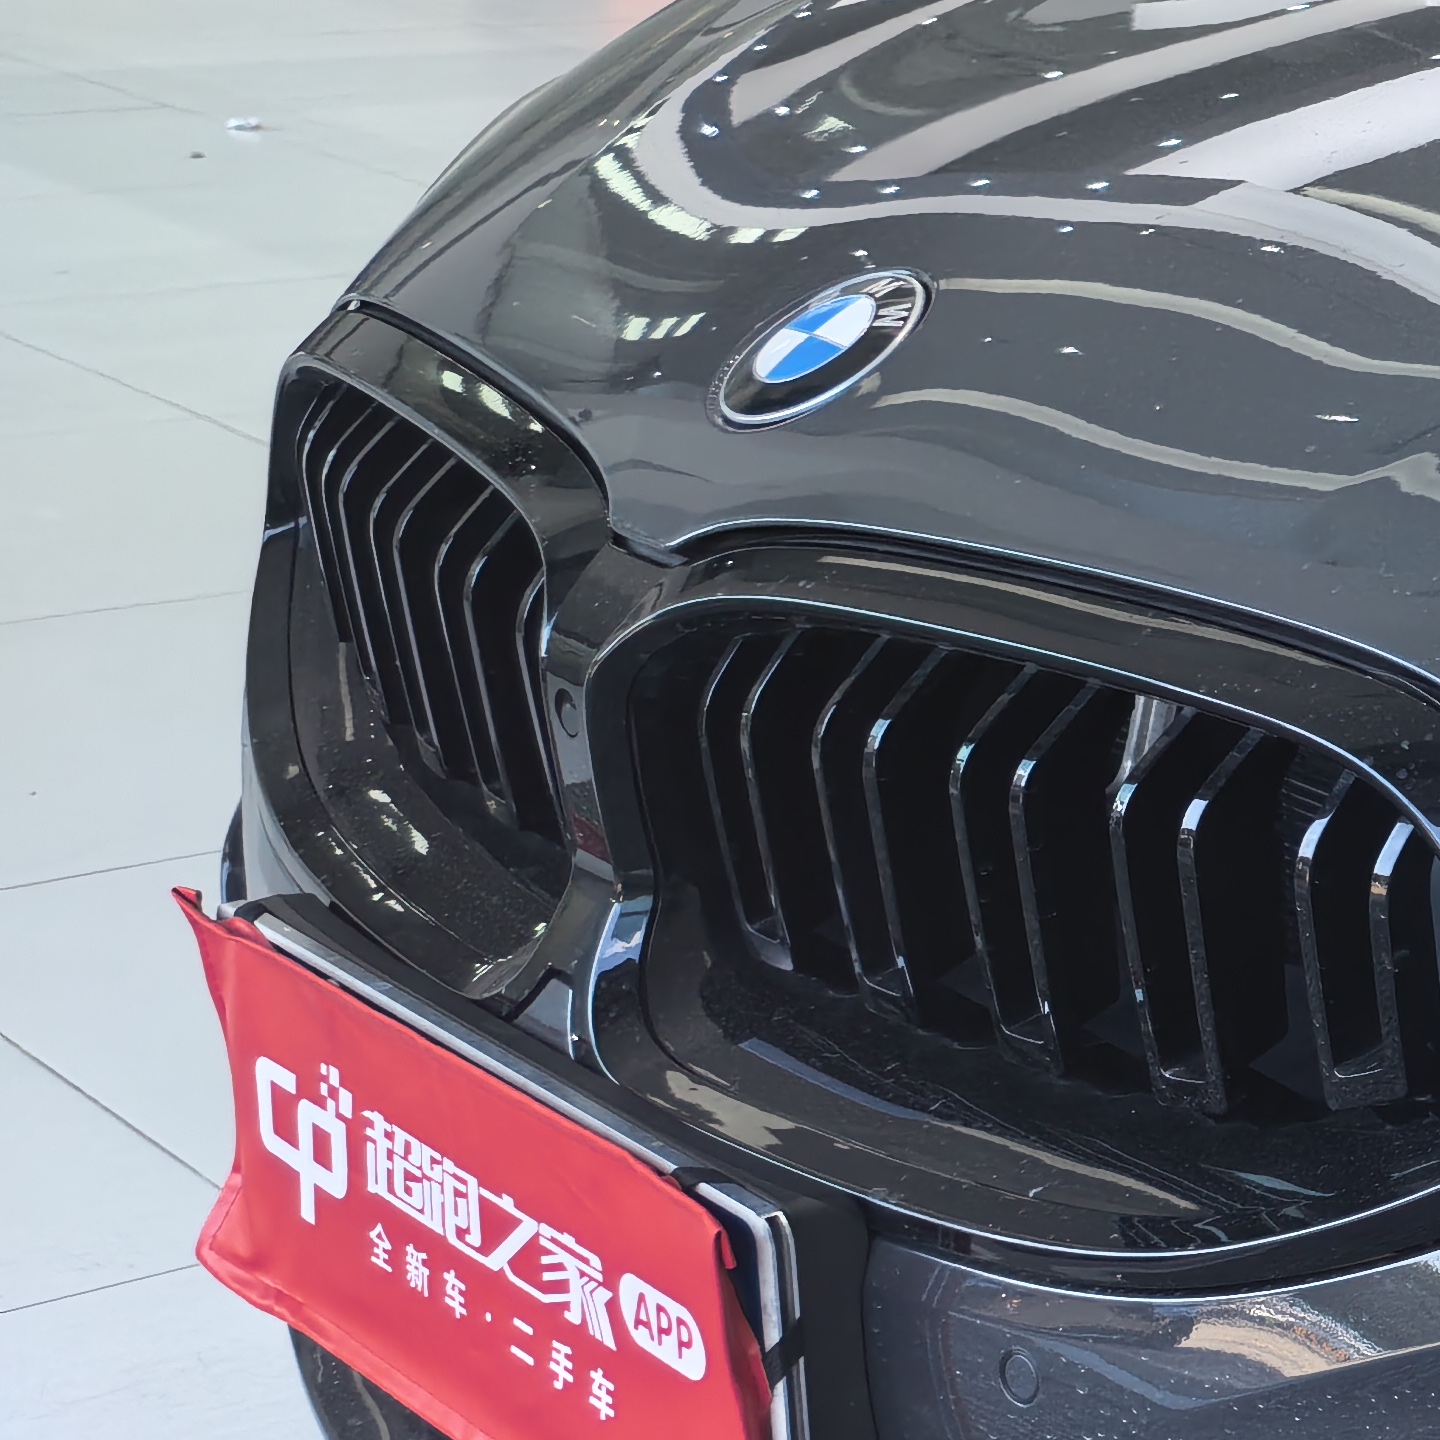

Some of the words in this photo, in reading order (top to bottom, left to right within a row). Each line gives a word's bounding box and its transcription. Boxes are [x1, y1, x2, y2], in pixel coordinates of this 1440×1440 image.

[360, 1109, 618, 1352] 超跑之家
[633, 1291, 694, 1361] APP
